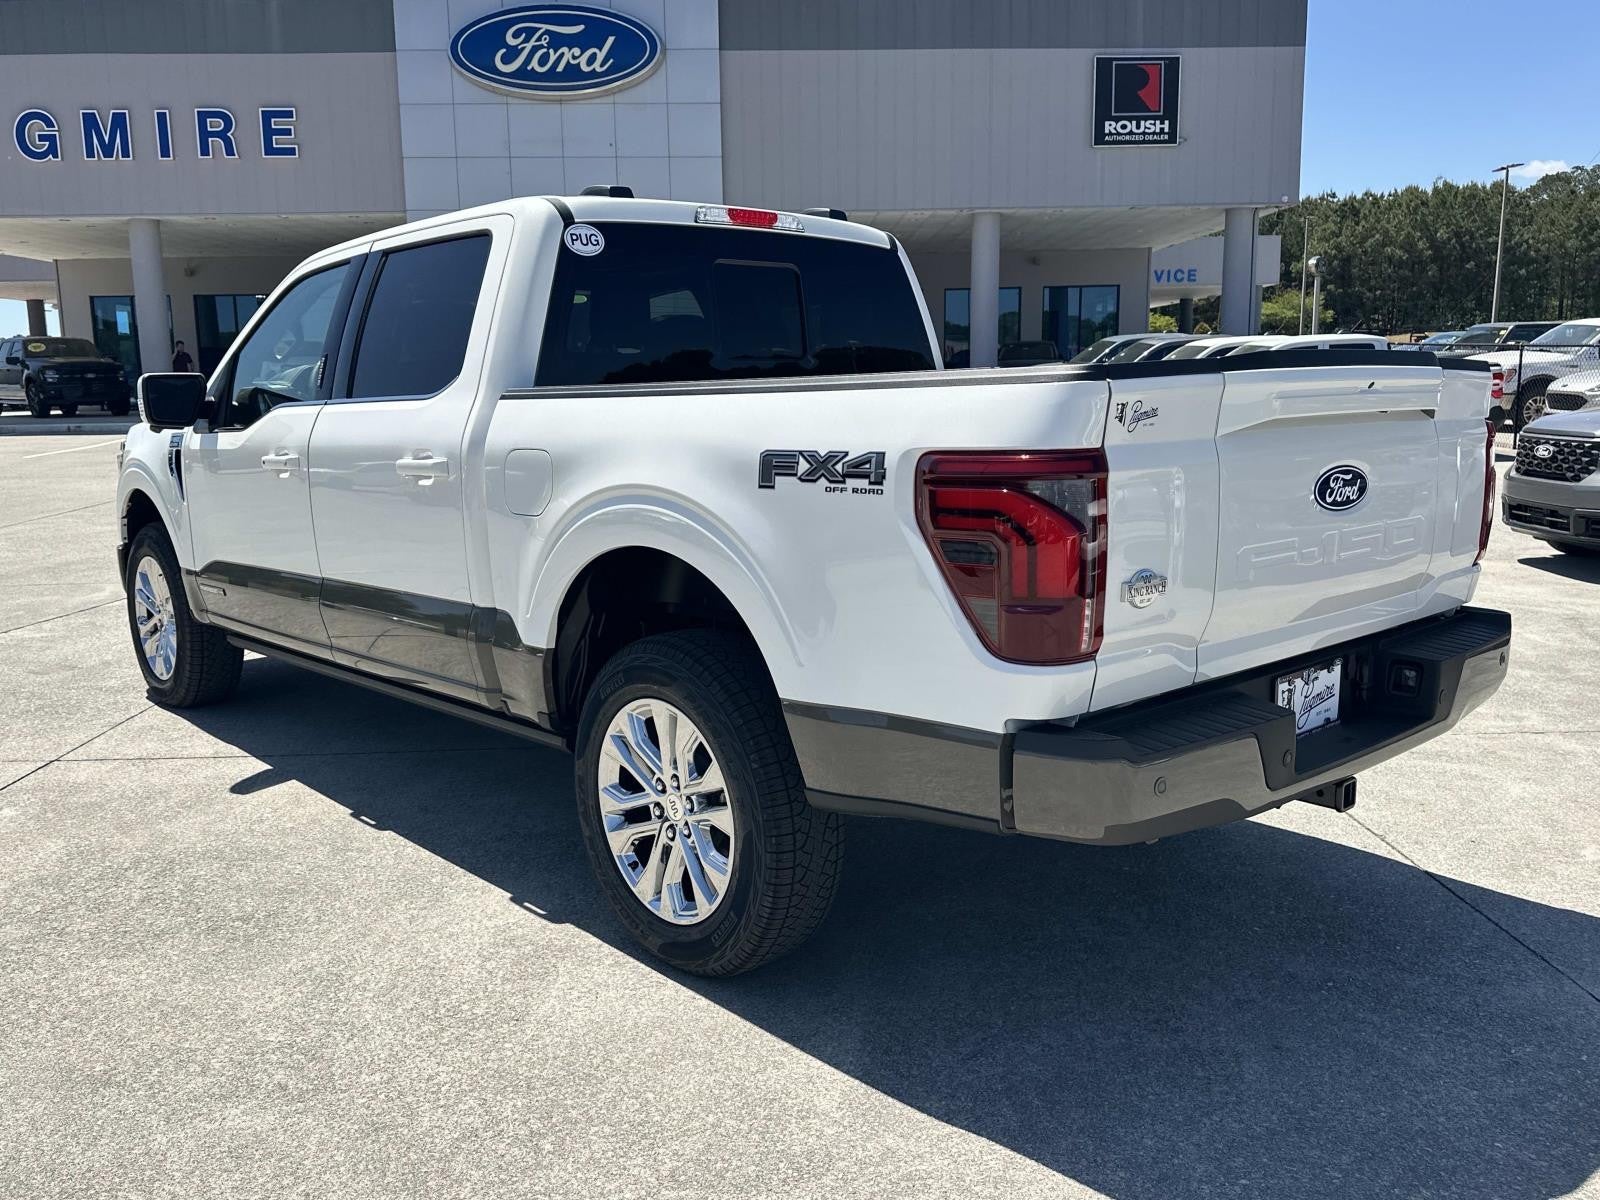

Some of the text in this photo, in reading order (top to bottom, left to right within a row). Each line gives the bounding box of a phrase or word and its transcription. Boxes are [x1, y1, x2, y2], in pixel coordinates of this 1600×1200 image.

[494, 22, 616, 73] Ford
[13, 107, 299, 162] GMIRE
[1104, 120, 1169, 134] ROUSH
[1104, 134, 1144, 142] AUTHORIZED
[569, 232, 600, 247] PUG
[1153, 268, 1198, 283] VICE
[758, 449, 886, 489] FX4
[824, 486, 884, 496] OFF ROAD
[1325, 473, 1361, 503] Ford
[1128, 581, 1167, 599] KING RANCH
